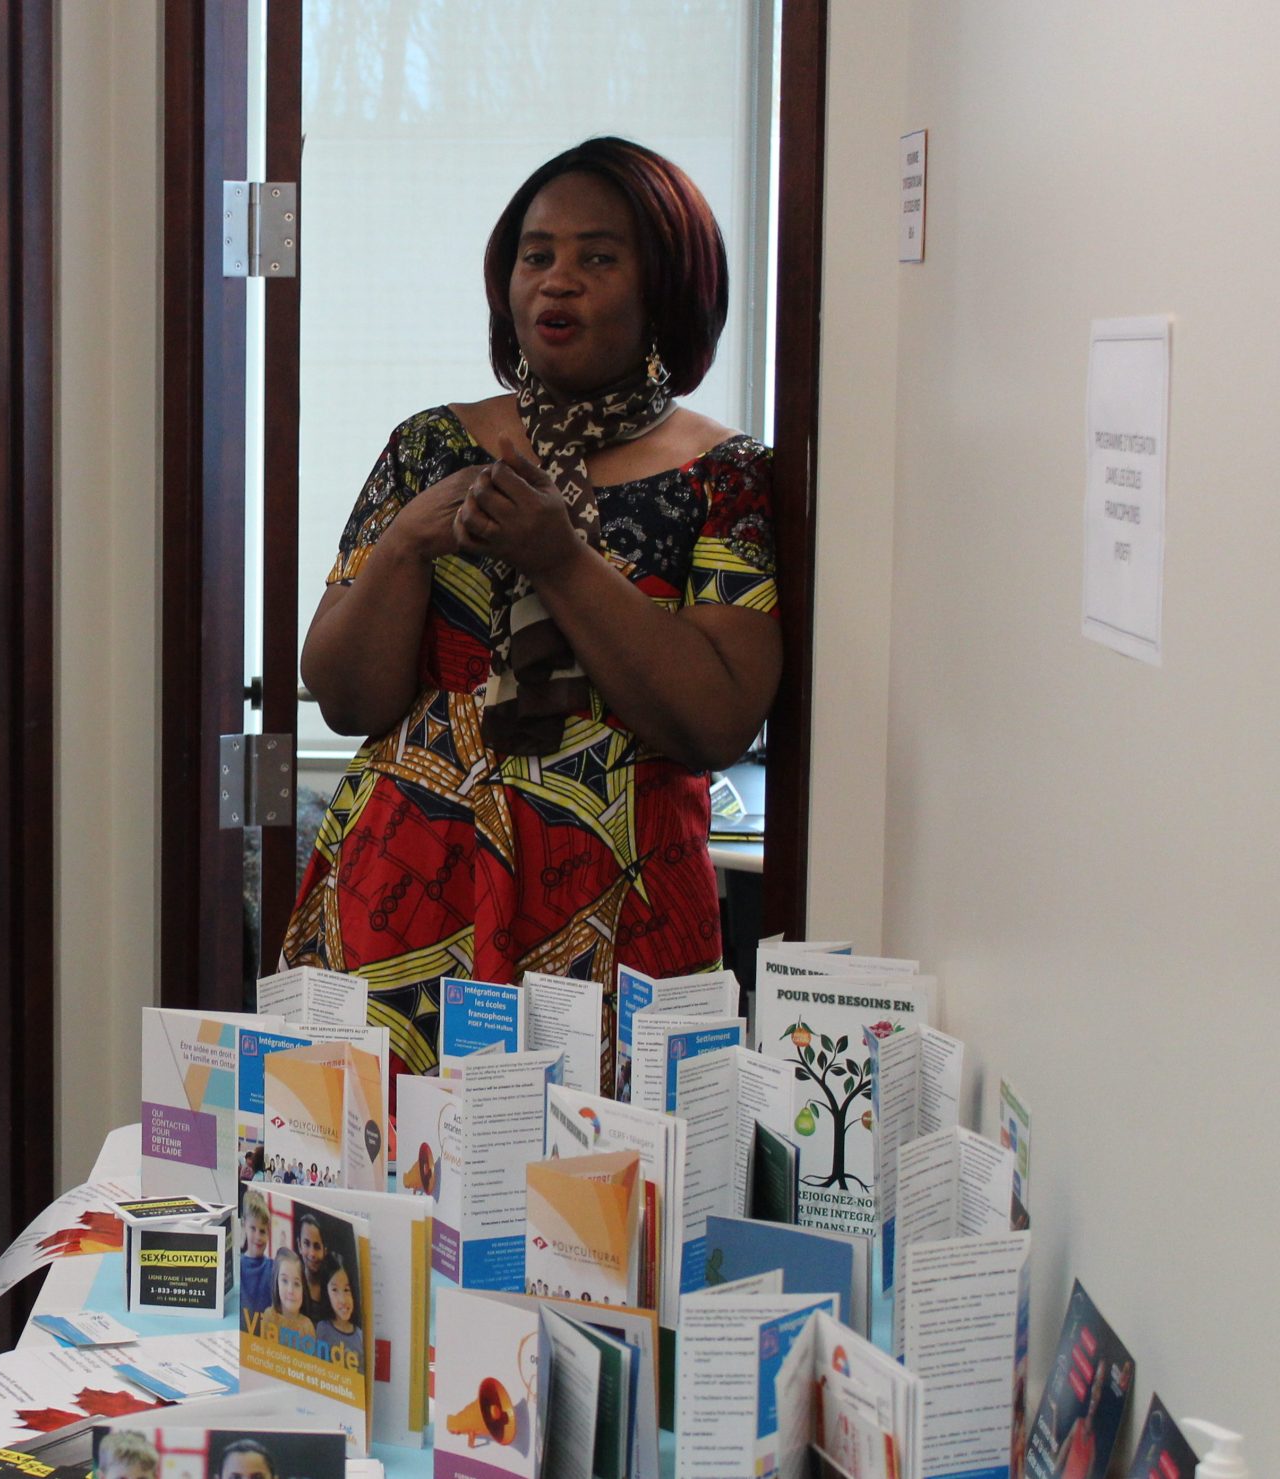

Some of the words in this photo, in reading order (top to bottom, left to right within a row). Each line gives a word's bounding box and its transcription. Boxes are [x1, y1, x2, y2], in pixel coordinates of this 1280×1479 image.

[766, 962, 789, 976] POUR
[464, 985, 500, 999] Intégration
[501, 988, 517, 1000] dans
[474, 997, 484, 1007] les
[485, 998, 507, 1011] écoles
[777, 989, 810, 1002] POUR
[812, 992, 835, 1004] VOS
[837, 994, 891, 1011] BESOINS
[893, 1000, 915, 1012] EN:
[468, 1009, 513, 1023] francophones
[259, 1035, 294, 1049] Intégration
[696, 1032, 731, 1044] Settlement
[183, 1052, 189, 1060] la
[190, 1053, 210, 1064] famille
[211, 1058, 219, 1066] en
[219, 1048, 232, 1059] droit
[151, 1108, 164, 1118] QUI
[151, 1117, 191, 1132] CONTACTER
[151, 1126, 170, 1137] POUR
[288, 1118, 338, 1137] POLYCULTURAL
[151, 1136, 182, 1148] OBTENIR
[151, 1144, 161, 1153] DE
[161, 1146, 183, 1157] L'AIDE
[806, 1206, 828, 1218] UNE
[140, 1253, 218, 1264] SEXPLOITATION
[552, 1239, 621, 1265] POLYCULTURAL
[150, 1287, 206, 1297] 1-833-999-9211
[243, 1308, 361, 1371] Viamonde
[250, 1342, 265, 1352] des
[266, 1348, 292, 1364] écoles
[292, 1356, 327, 1377] ouvertes
[327, 1369, 341, 1380] sur
[341, 1375, 353, 1385] un
[247, 1353, 274, 1370] monde
[287, 1366, 305, 1381] tout
[306, 1375, 319, 1386] est
[320, 1379, 356, 1400] possible.
